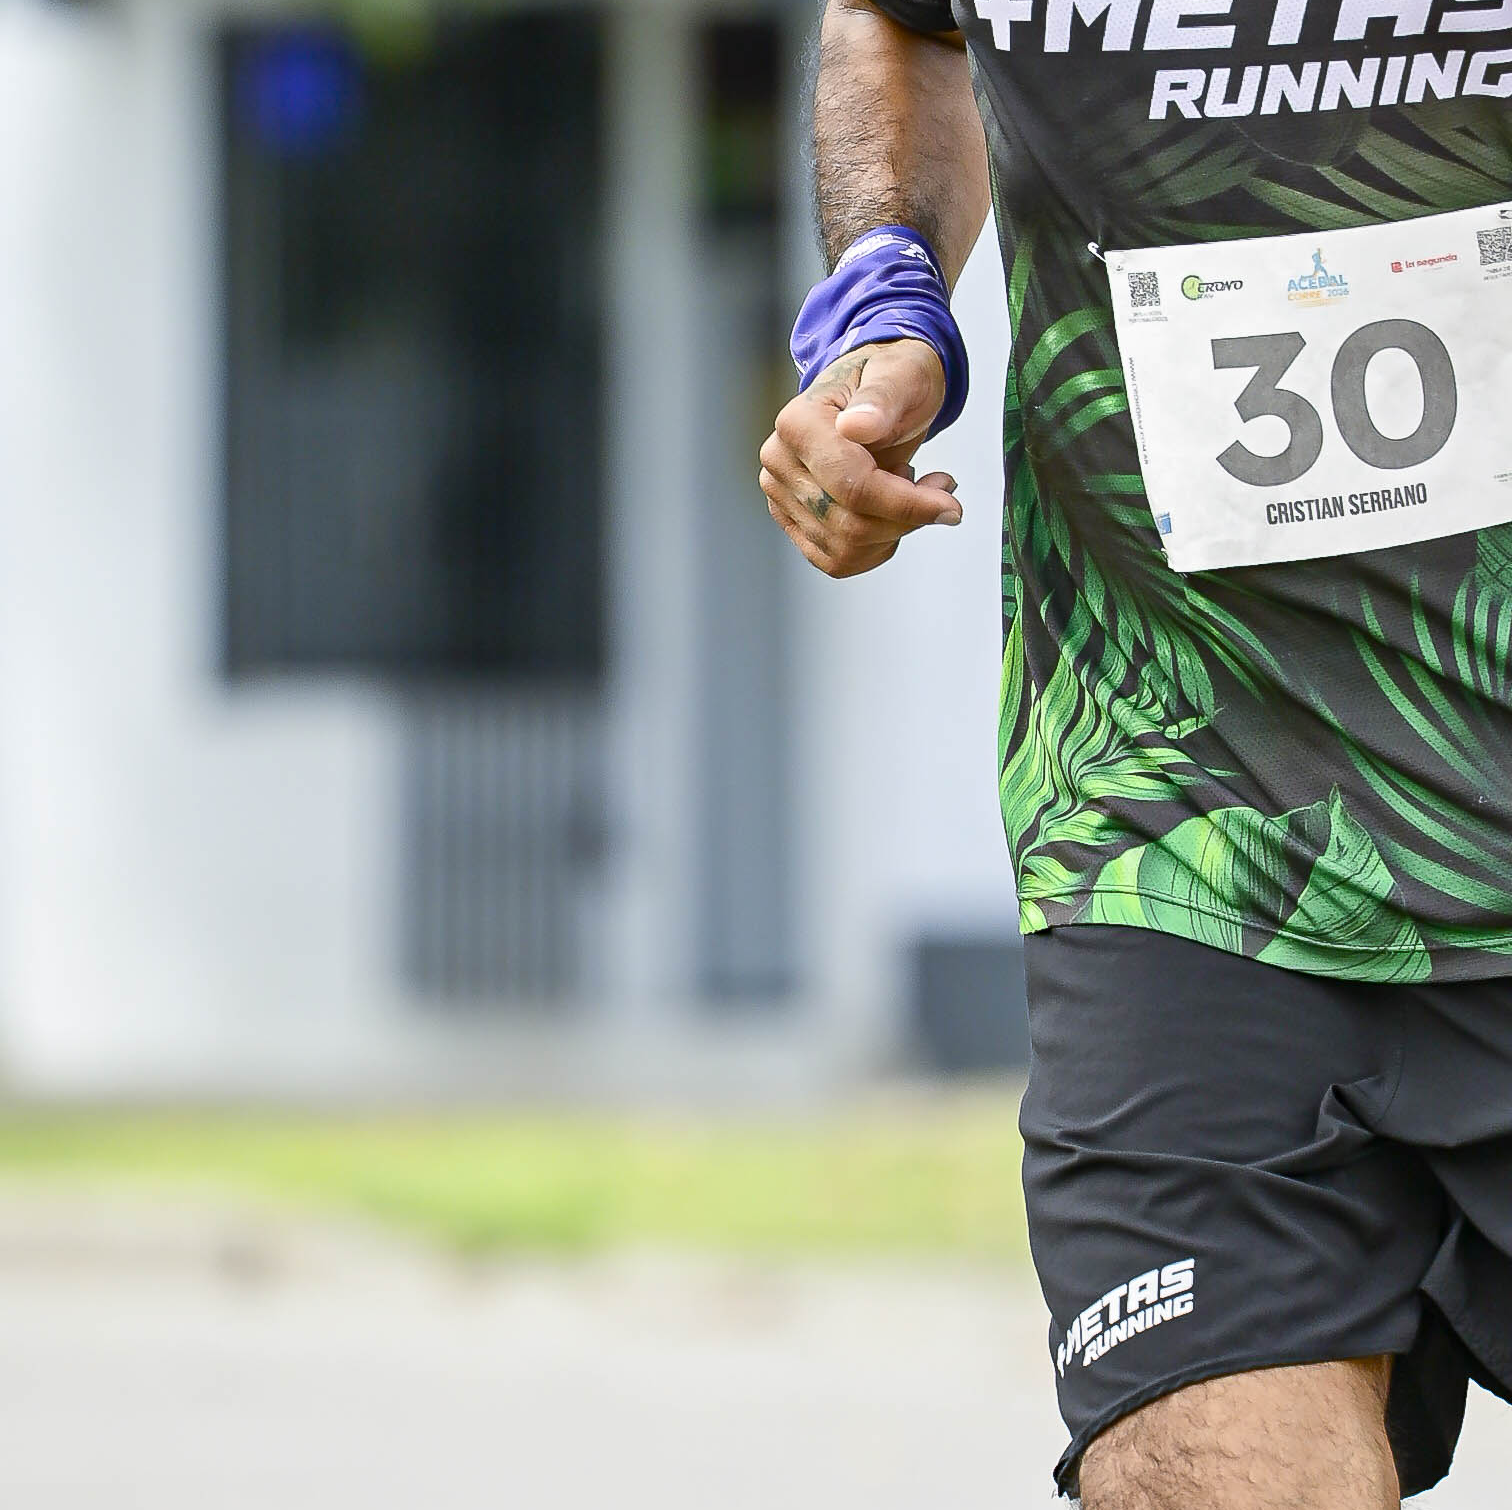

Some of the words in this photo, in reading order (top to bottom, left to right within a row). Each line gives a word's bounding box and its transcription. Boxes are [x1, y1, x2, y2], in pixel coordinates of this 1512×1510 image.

[1417, 253, 1457, 267] segunda
[1287, 274, 1349, 292] ACEBAL
[1210, 318, 1458, 487] 30
[1266, 496, 1345, 525] CRISTIAN
[1348, 482, 1428, 516] SERRANO
[1082, 1292, 1194, 1367] RUNNING
